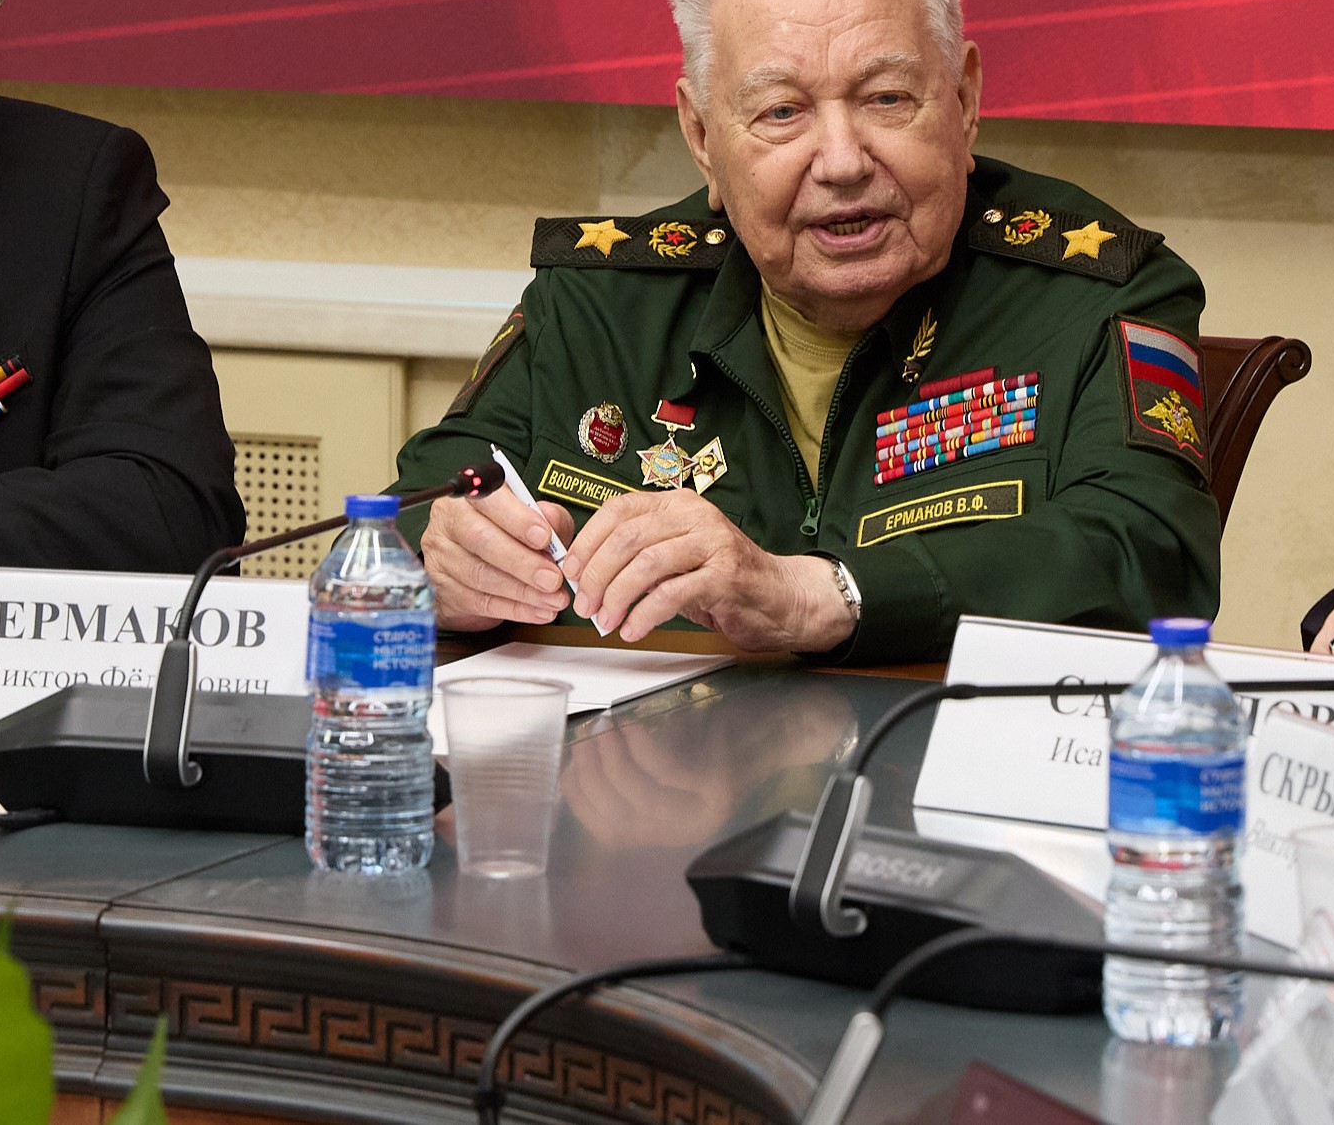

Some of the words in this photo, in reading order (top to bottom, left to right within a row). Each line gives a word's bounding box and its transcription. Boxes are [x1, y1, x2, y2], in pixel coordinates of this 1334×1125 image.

[548, 470, 622, 502] ВООРУЖЕНН
[885, 500, 954, 531] ЕРМАКОВ
[956, 494, 988, 513] В.Ф.
[99, 665, 270, 695] Фёович
[1051, 737, 1103, 766] Иса
